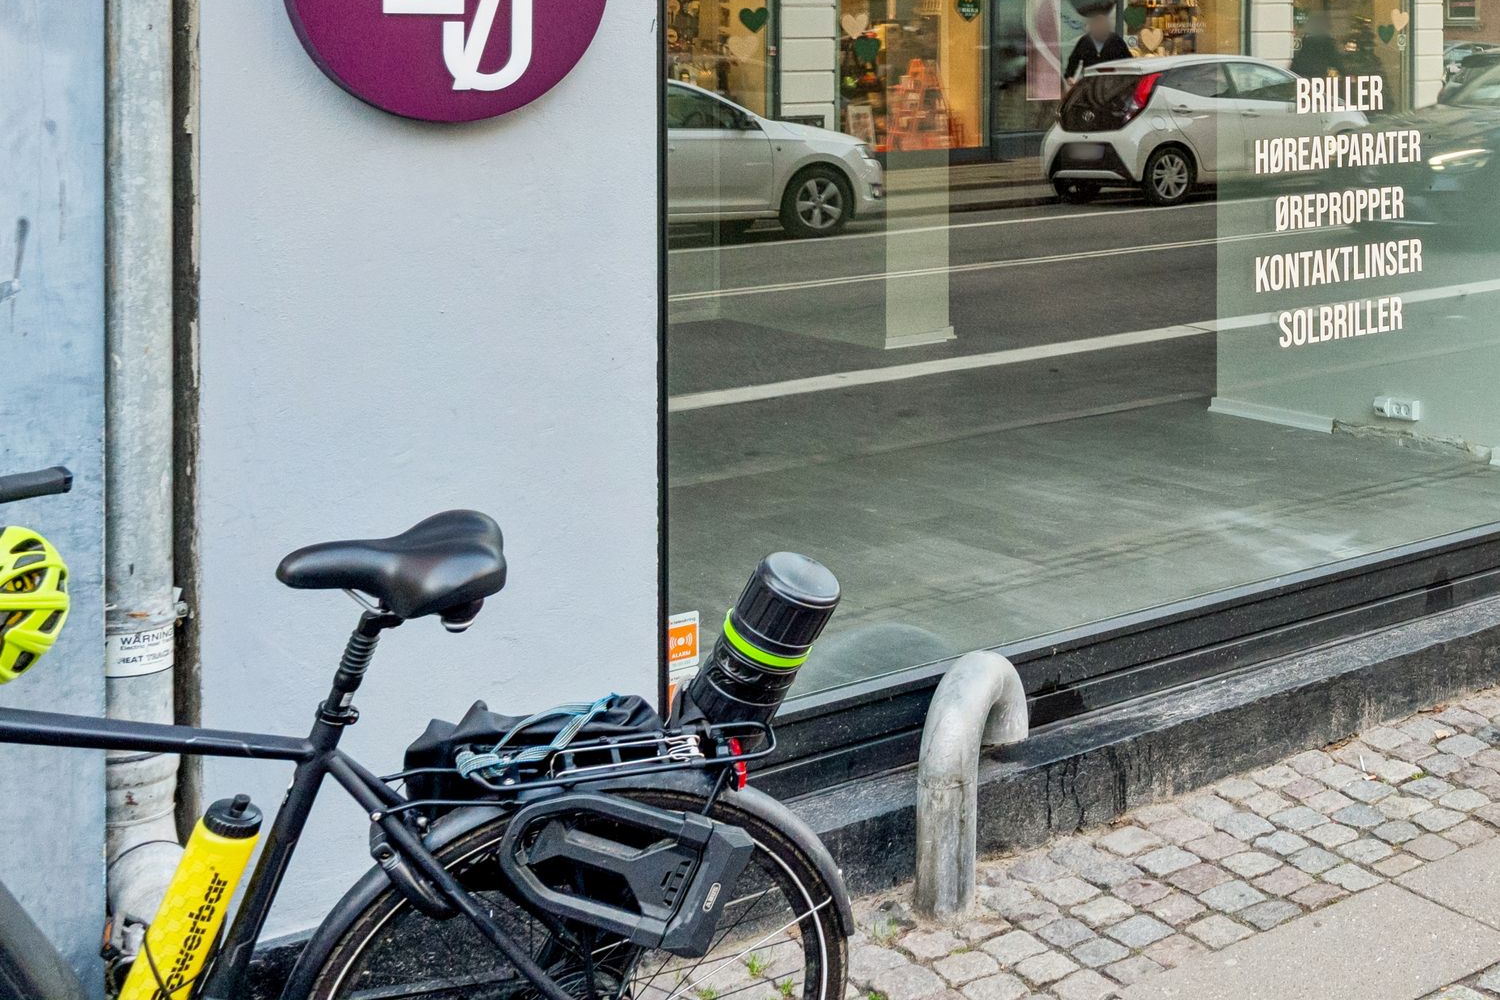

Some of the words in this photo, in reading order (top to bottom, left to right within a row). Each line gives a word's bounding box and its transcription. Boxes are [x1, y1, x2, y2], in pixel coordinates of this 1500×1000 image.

[1296, 75, 1383, 114] BRILLER
[1255, 130, 1421, 174] HØREAPPARATER
[1275, 186, 1404, 232] ØREPROPPER
[1255, 239, 1422, 293] KONTAKTLINSER
[1279, 296, 1403, 348] SOLBRILLER
